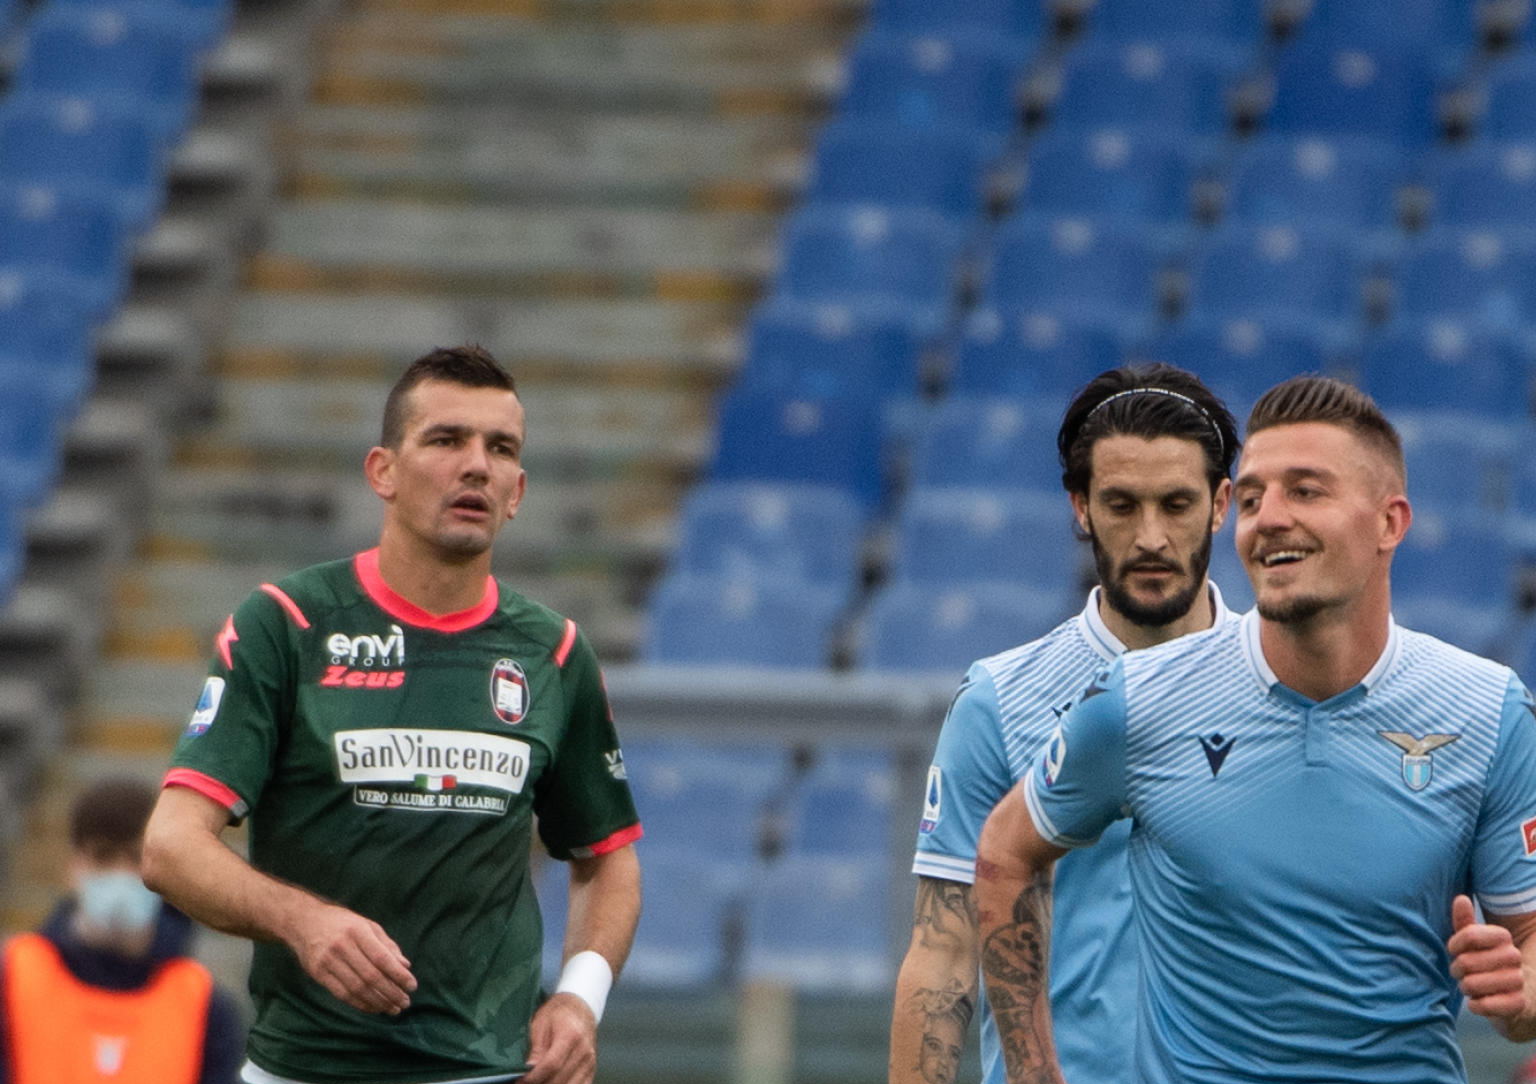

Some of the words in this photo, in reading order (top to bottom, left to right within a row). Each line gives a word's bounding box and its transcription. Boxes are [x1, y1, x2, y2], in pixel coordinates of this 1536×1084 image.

[321, 665, 406, 689] Zeus
[358, 790, 389, 804] VERO
[390, 792, 436, 807] SALUME
[438, 795, 452, 807] DI
